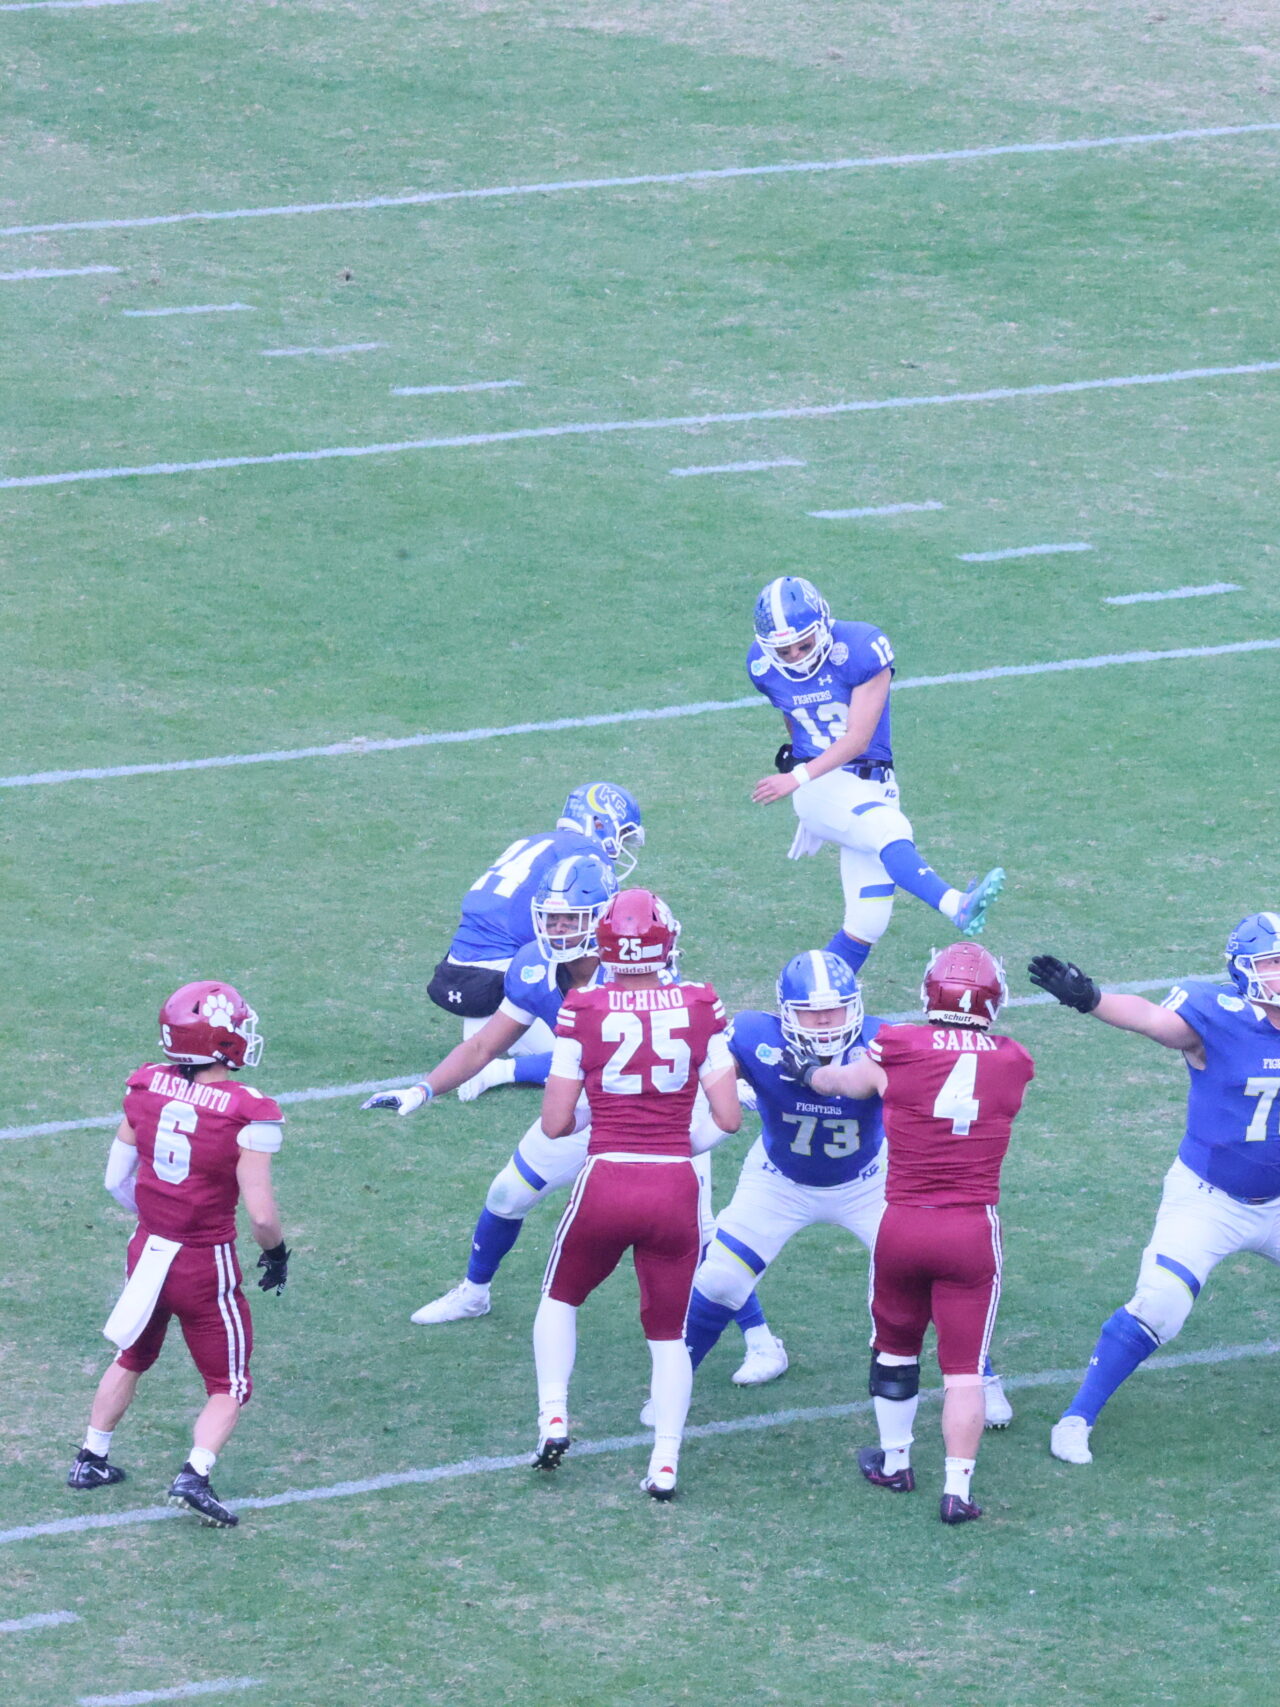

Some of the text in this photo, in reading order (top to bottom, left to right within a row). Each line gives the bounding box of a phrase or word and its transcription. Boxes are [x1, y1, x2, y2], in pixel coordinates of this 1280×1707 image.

[870, 636, 895, 667] 12
[792, 690, 832, 706] FIGHTERS
[618, 938, 642, 961] 25
[610, 965, 652, 974] Riddell
[608, 988, 684, 1012] UCHINO
[958, 989, 972, 1012] 4
[943, 1013, 972, 1023] schutt
[162, 1024, 173, 1048] 6
[601, 1007, 691, 1094] 25
[933, 1053, 979, 1136] 4
[796, 1101, 842, 1116] FIGHTERS
[152, 1099, 198, 1185] 6
[782, 1112, 860, 1159] 73
